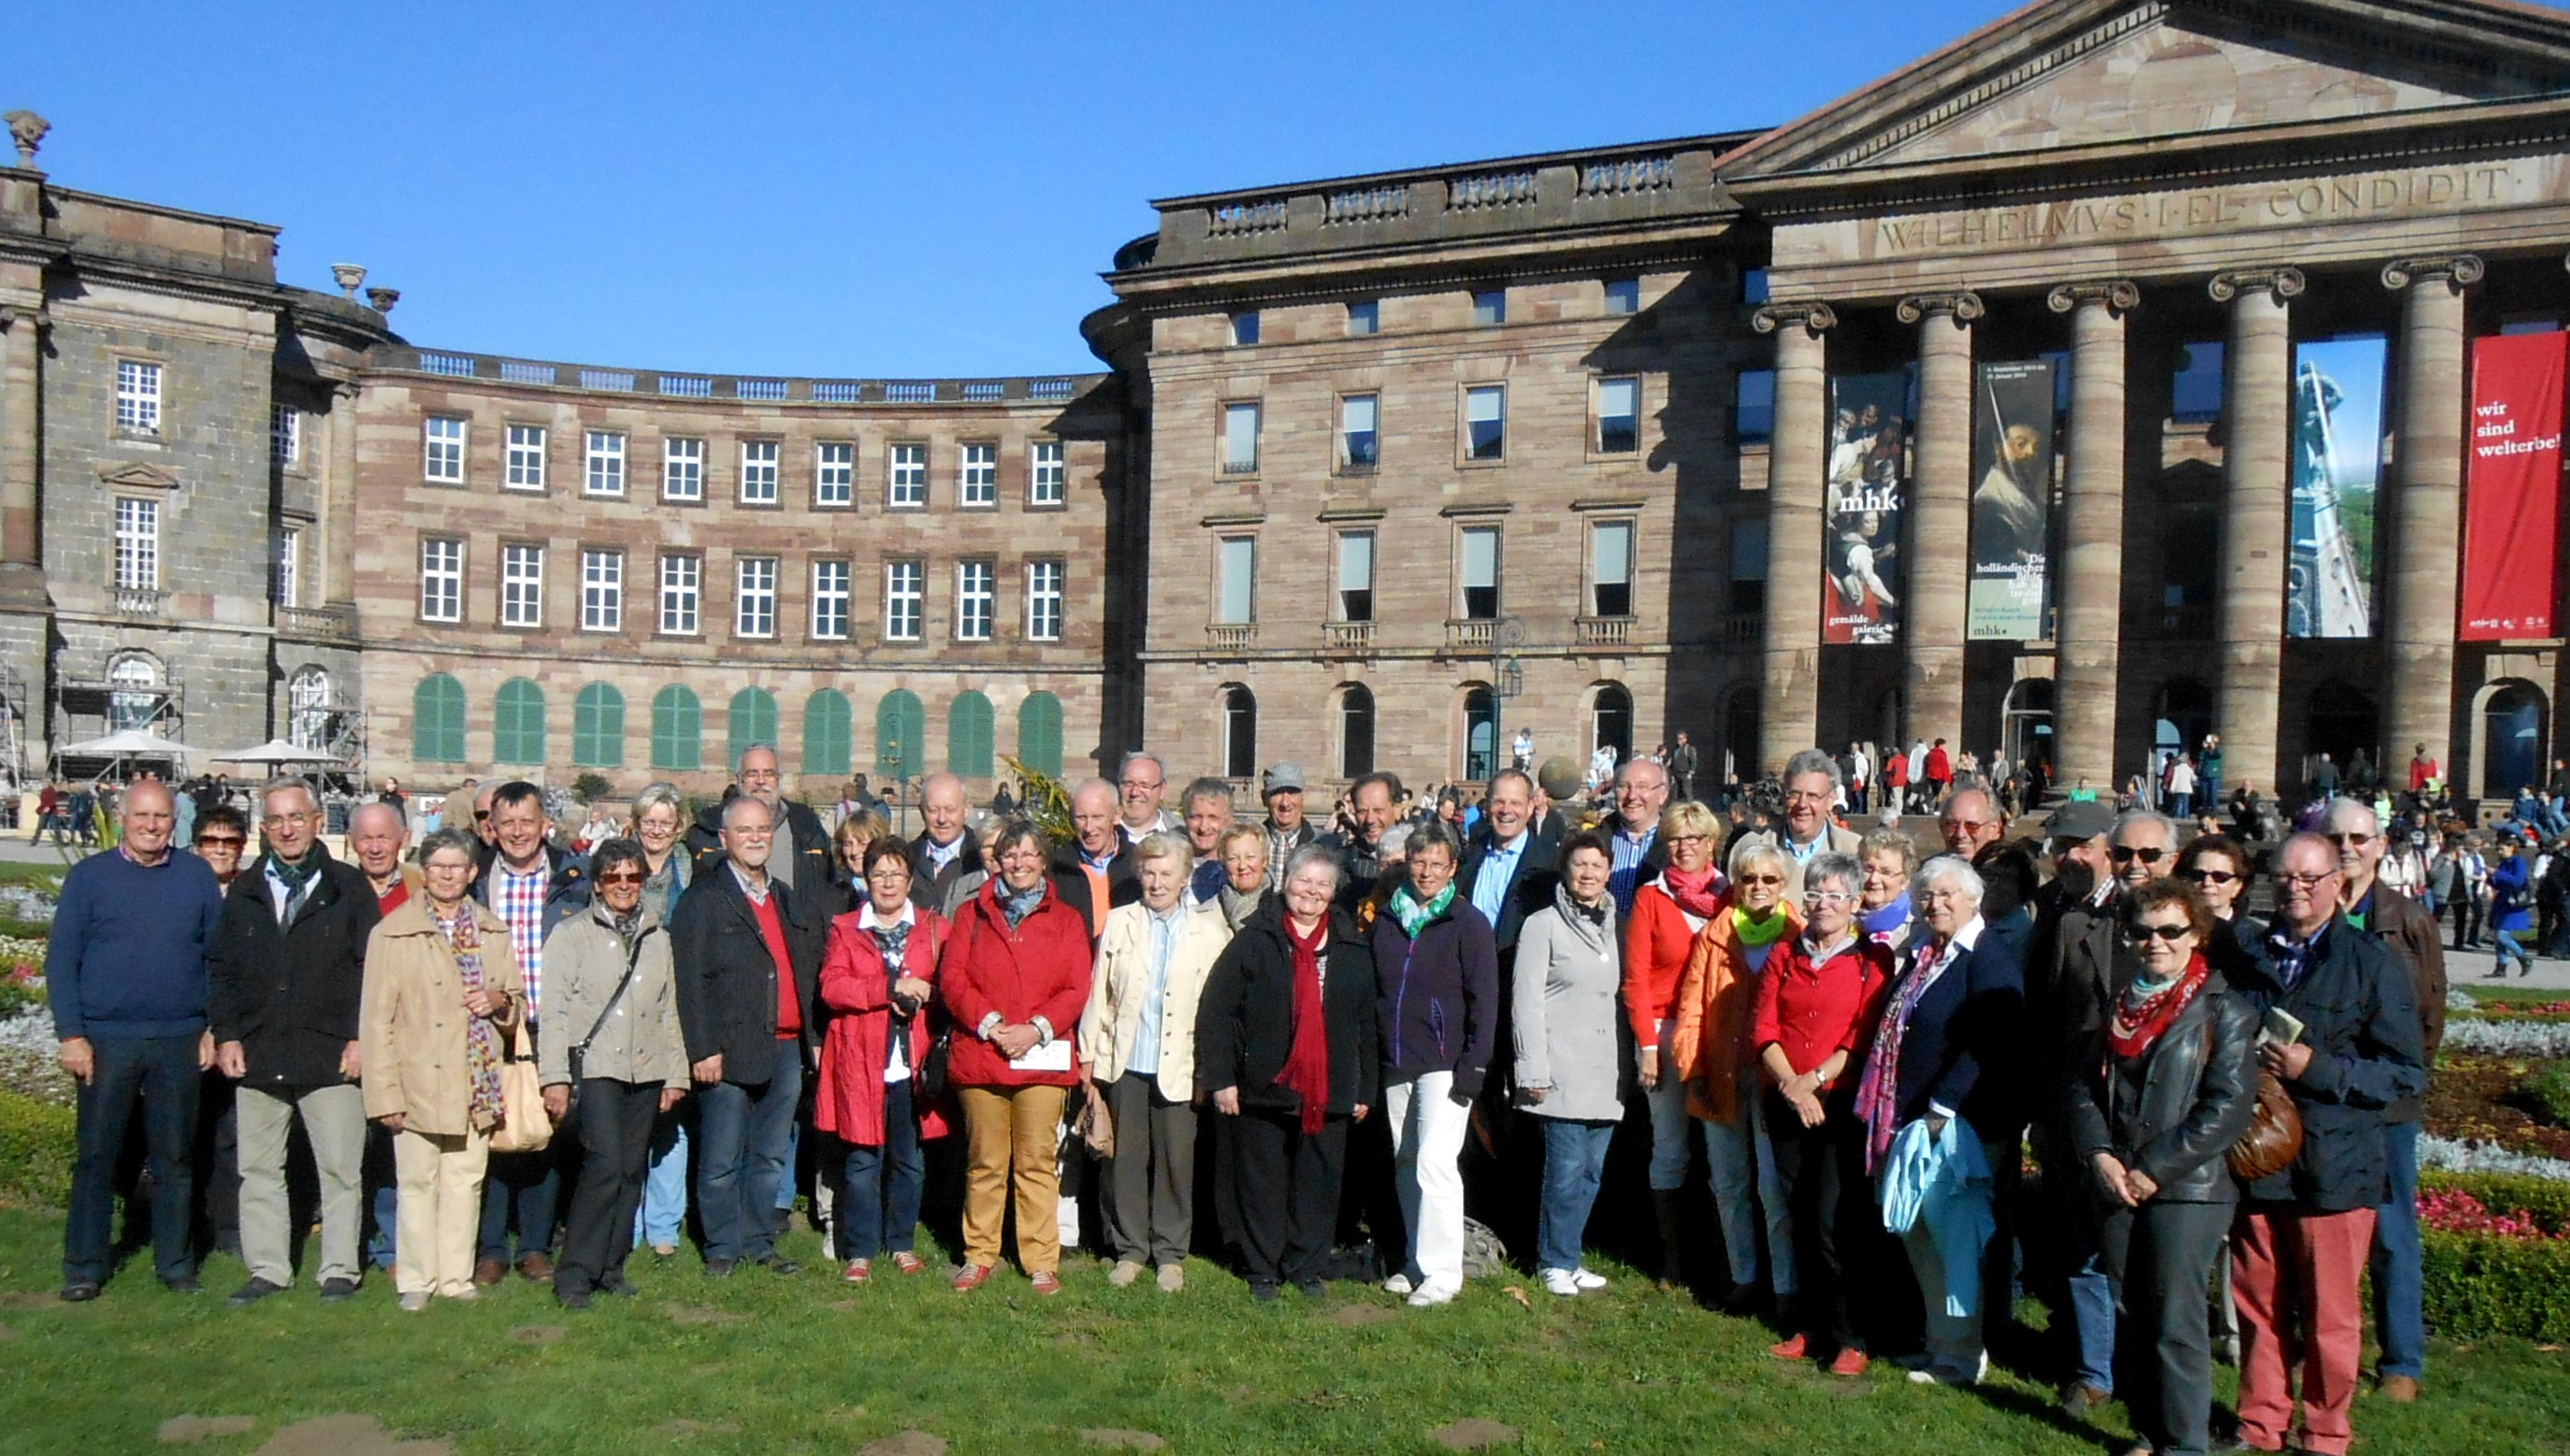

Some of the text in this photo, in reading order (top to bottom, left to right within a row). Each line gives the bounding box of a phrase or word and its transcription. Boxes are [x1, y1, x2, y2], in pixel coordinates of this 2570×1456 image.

[2476, 400, 2507, 417] wir
[2476, 419, 2515, 438] sind
[2477, 433, 2561, 457] welterbe!
[1828, 613, 1869, 627] gemälde
[1852, 624, 1885, 637] galerie
